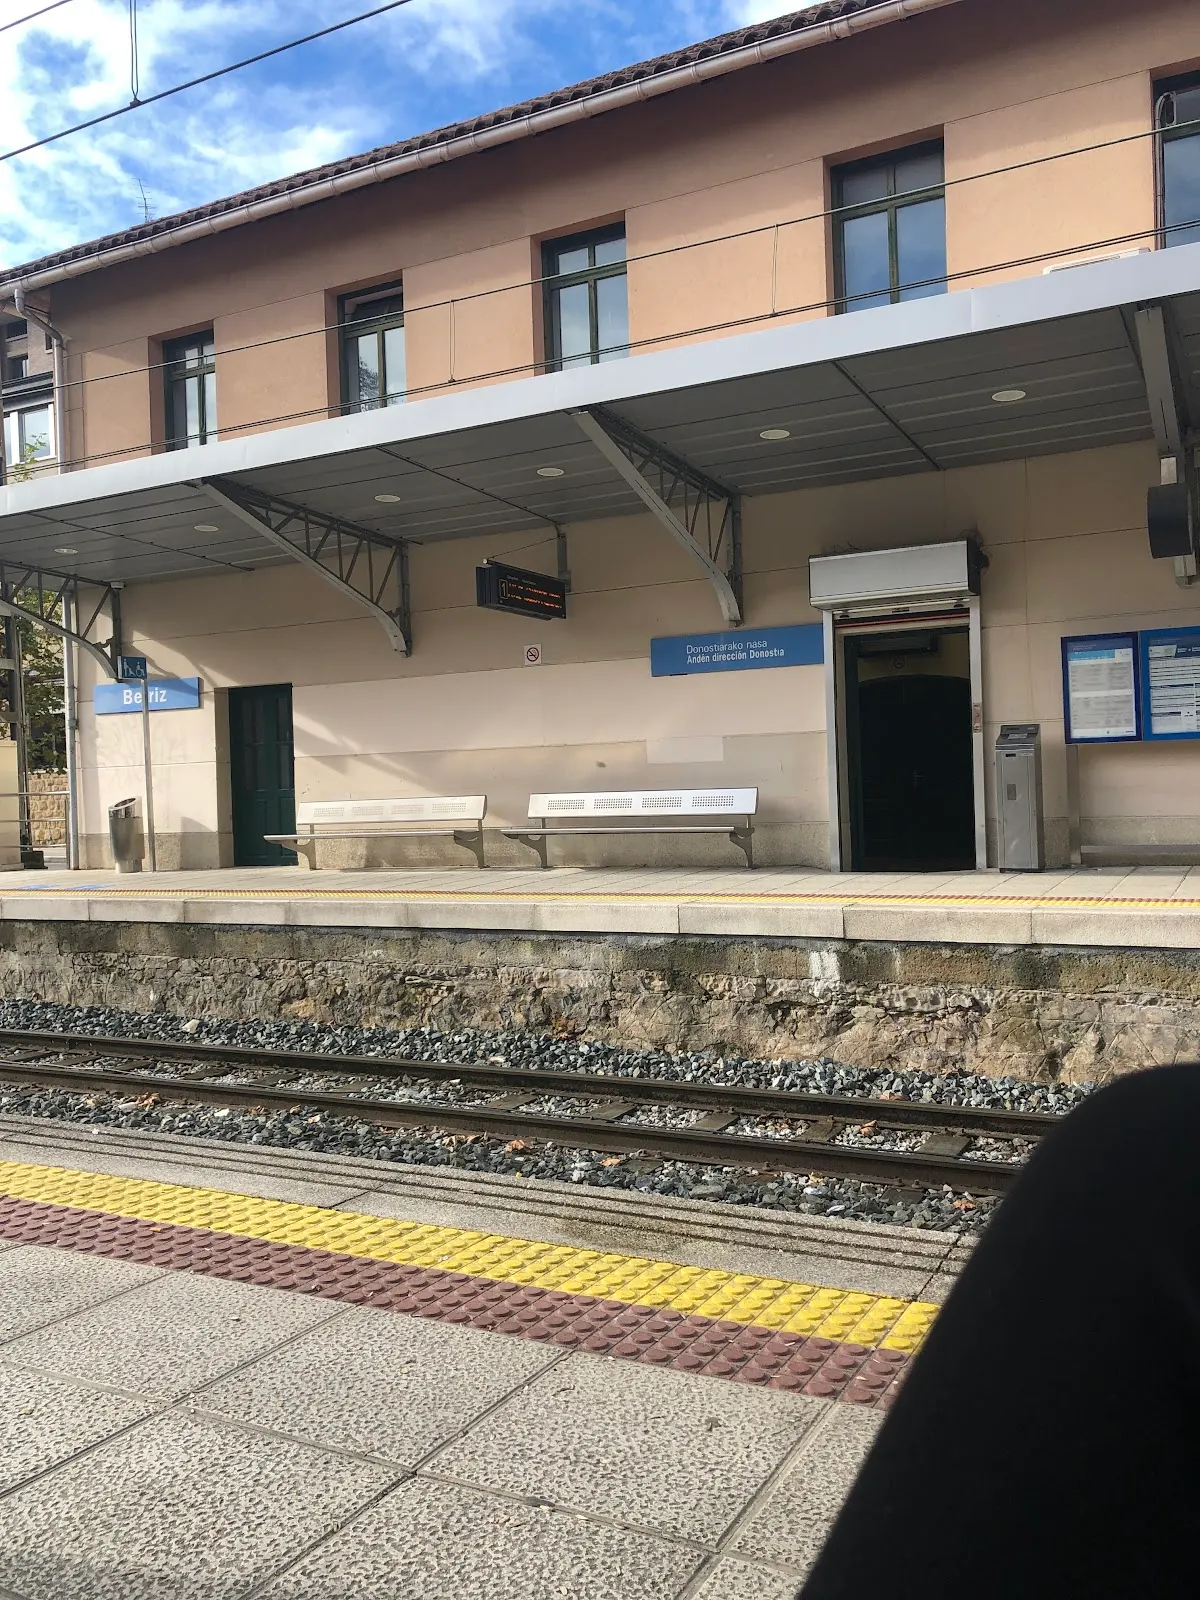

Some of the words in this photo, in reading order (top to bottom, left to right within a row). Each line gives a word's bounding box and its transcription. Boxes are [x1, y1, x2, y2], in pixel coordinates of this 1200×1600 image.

[686, 641, 743, 654] Donostiarako
[746, 640, 768, 649] nasa
[687, 654, 710, 664] Andén
[712, 651, 747, 662] dirección
[749, 648, 785, 659] Donostia
[123, 687, 167, 705] Beriz
